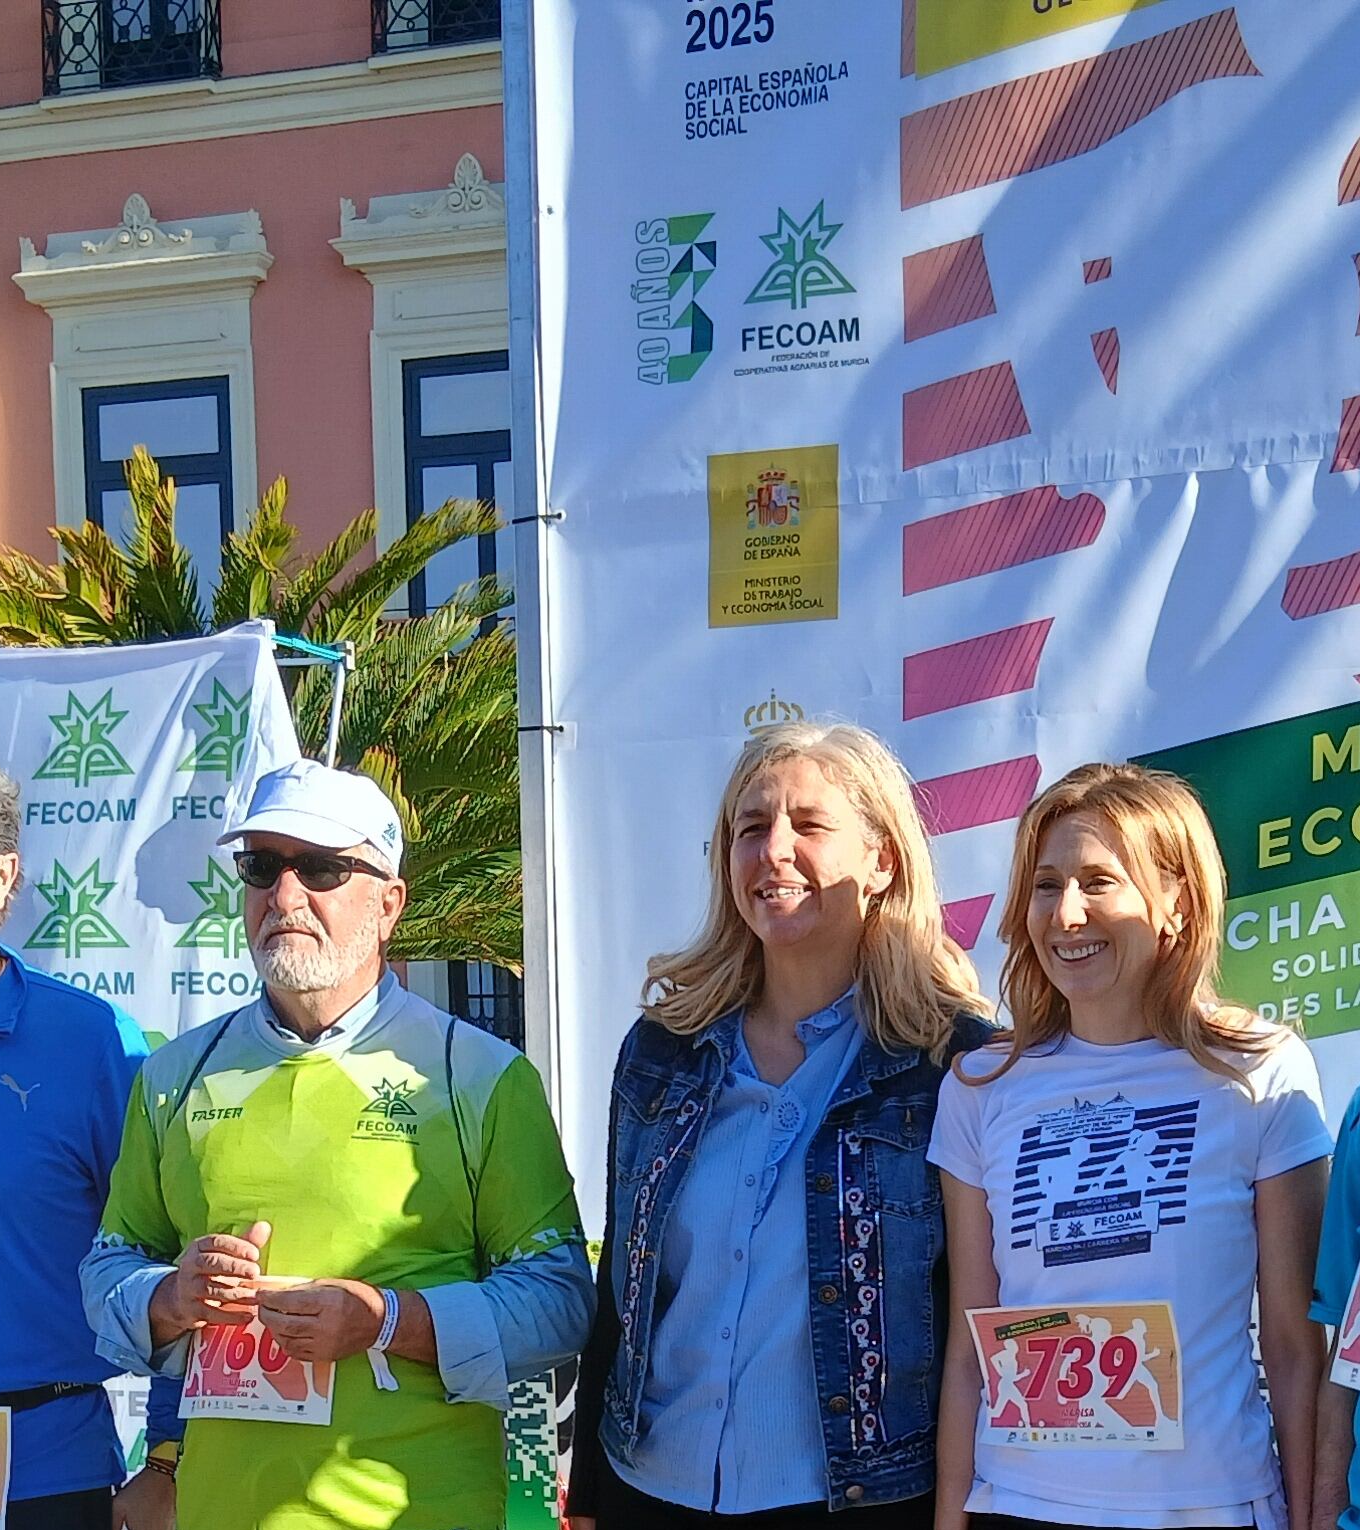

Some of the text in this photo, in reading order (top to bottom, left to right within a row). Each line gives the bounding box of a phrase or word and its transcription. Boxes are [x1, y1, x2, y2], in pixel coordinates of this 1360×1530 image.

[685, 0, 775, 53] 2025
[685, 61, 849, 100] CAPITAL ESPAÑOLA
[685, 83, 829, 120] DE LA ECONOMÍA
[685, 116, 748, 140] SOCIAL
[631, 218, 671, 330] AÑOS
[741, 317, 860, 352] FECOAM
[744, 534, 800, 548] GOBIERNO
[744, 546, 801, 561] DE ESPAÑA
[744, 575, 801, 588] MINISTERIO
[744, 588, 802, 601] DE TRABAJO
[722, 598, 824, 614] Y ECONOMÍA SOCIAL
[25, 798, 137, 826] FECOAM
[191, 1106, 243, 1122] FASTER
[356, 1119, 418, 1135] FECOAM
[1094, 1210, 1143, 1227] FECOAM
[1024, 1336, 1138, 1400] 739
